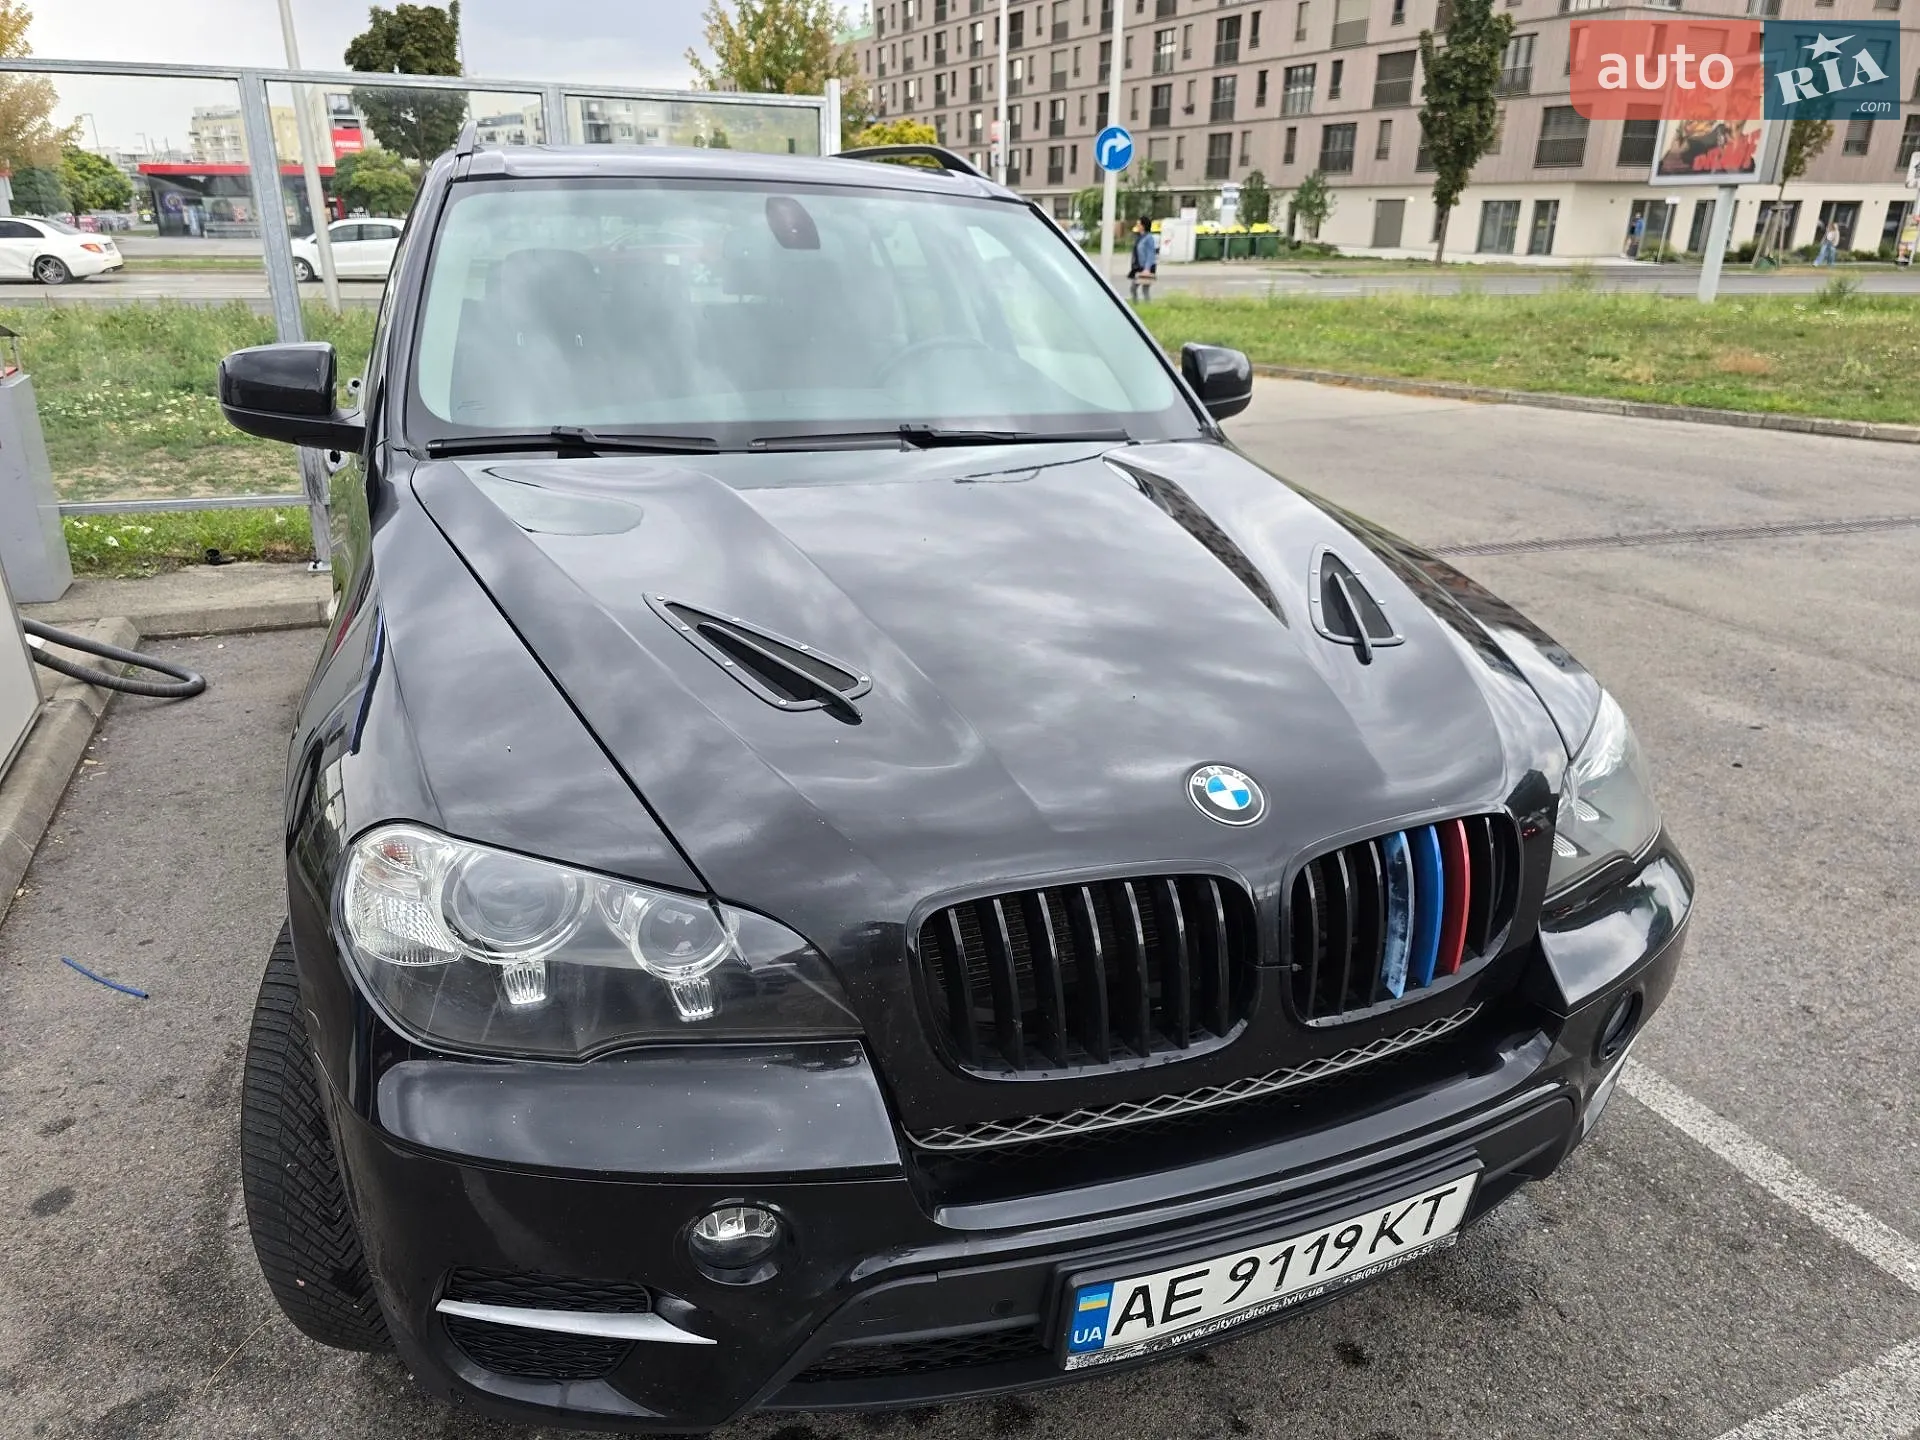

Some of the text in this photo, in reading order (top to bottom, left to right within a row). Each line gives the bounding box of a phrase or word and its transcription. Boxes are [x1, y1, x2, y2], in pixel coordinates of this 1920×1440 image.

[1193, 766, 1248, 787] BMW
[1111, 1187, 1458, 1336] AE 9119 KT
[1073, 1326, 1103, 1344] UA
[1171, 1286, 1324, 1345] www.citymotors.lviv.ua
